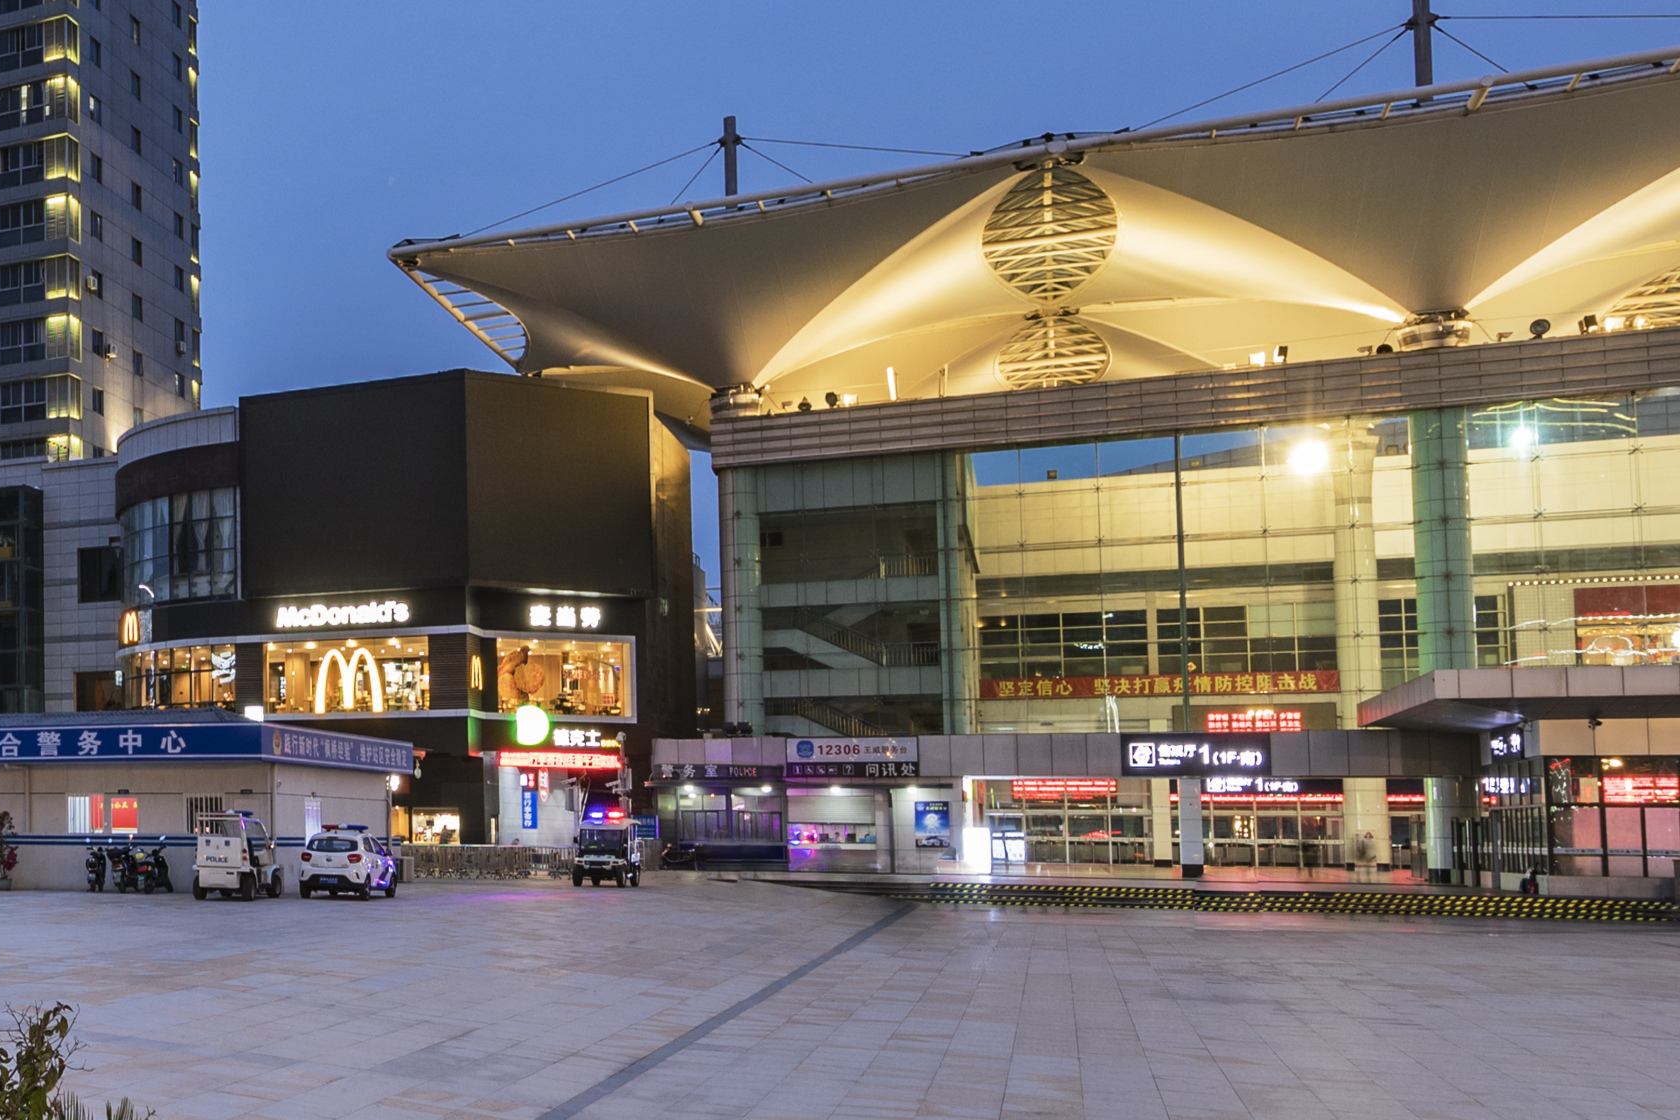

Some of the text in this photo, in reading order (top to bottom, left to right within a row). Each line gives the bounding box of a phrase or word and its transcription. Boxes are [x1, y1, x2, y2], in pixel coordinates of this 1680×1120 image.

[275, 600, 410, 628] McDonald's
[529, 604, 601, 628] 麦当劳
[998, 673, 1318, 697] 坚定信心 坚决打赢疫情防控阻击战
[817, 744, 908, 756] 12306 王威服务台
[661, 764, 758, 778] 警务室 POLICE
[865, 763, 916, 778] 问讯处
[205, 855, 229, 864] POLICE
